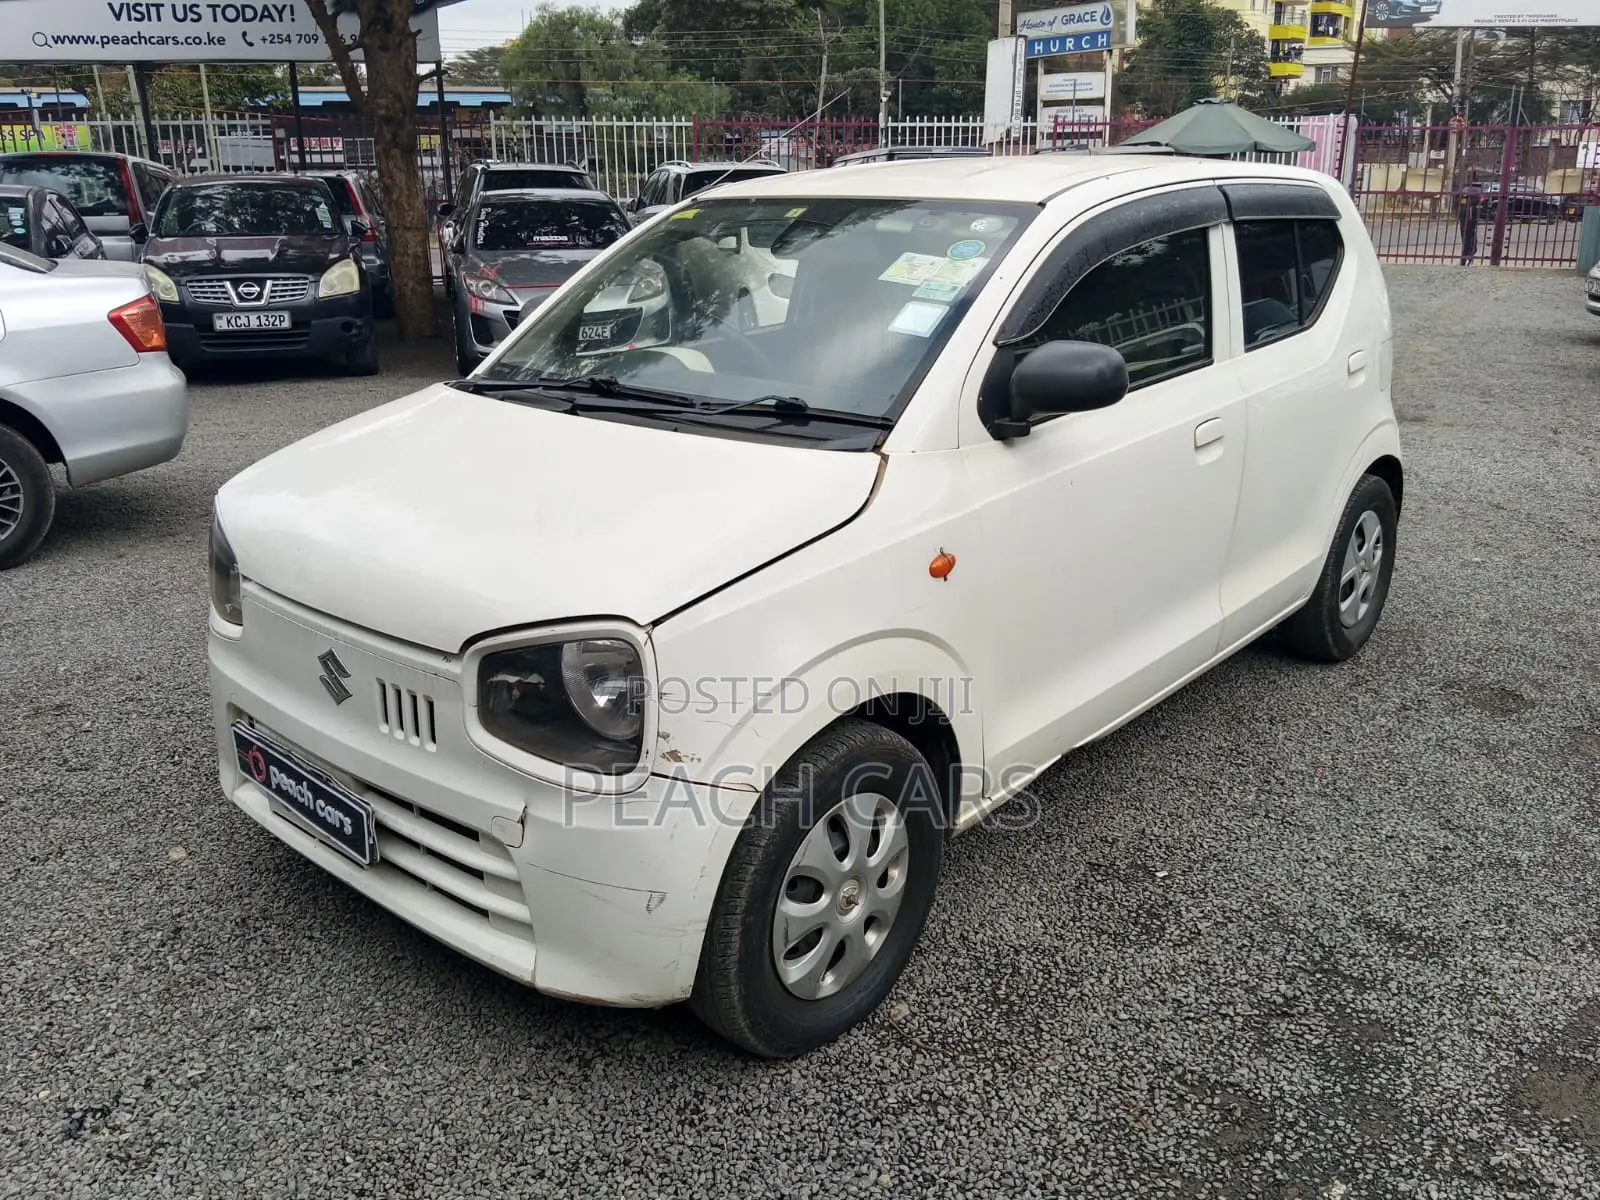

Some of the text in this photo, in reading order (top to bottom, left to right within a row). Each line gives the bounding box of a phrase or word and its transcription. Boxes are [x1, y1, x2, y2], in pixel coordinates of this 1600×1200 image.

[107, 2, 295, 23] VISIT US TODAY!
[1061, 11, 1097, 25] GRACE
[51, 31, 226, 49] www.peachcars.co.ke
[260, 34, 292, 45] +254
[296, 34, 319, 45] 709
[1034, 34, 1107, 54] HURCH
[226, 314, 286, 328] KCJ 132P
[581, 326, 609, 339] 624E
[269, 765, 353, 836] peach cars
